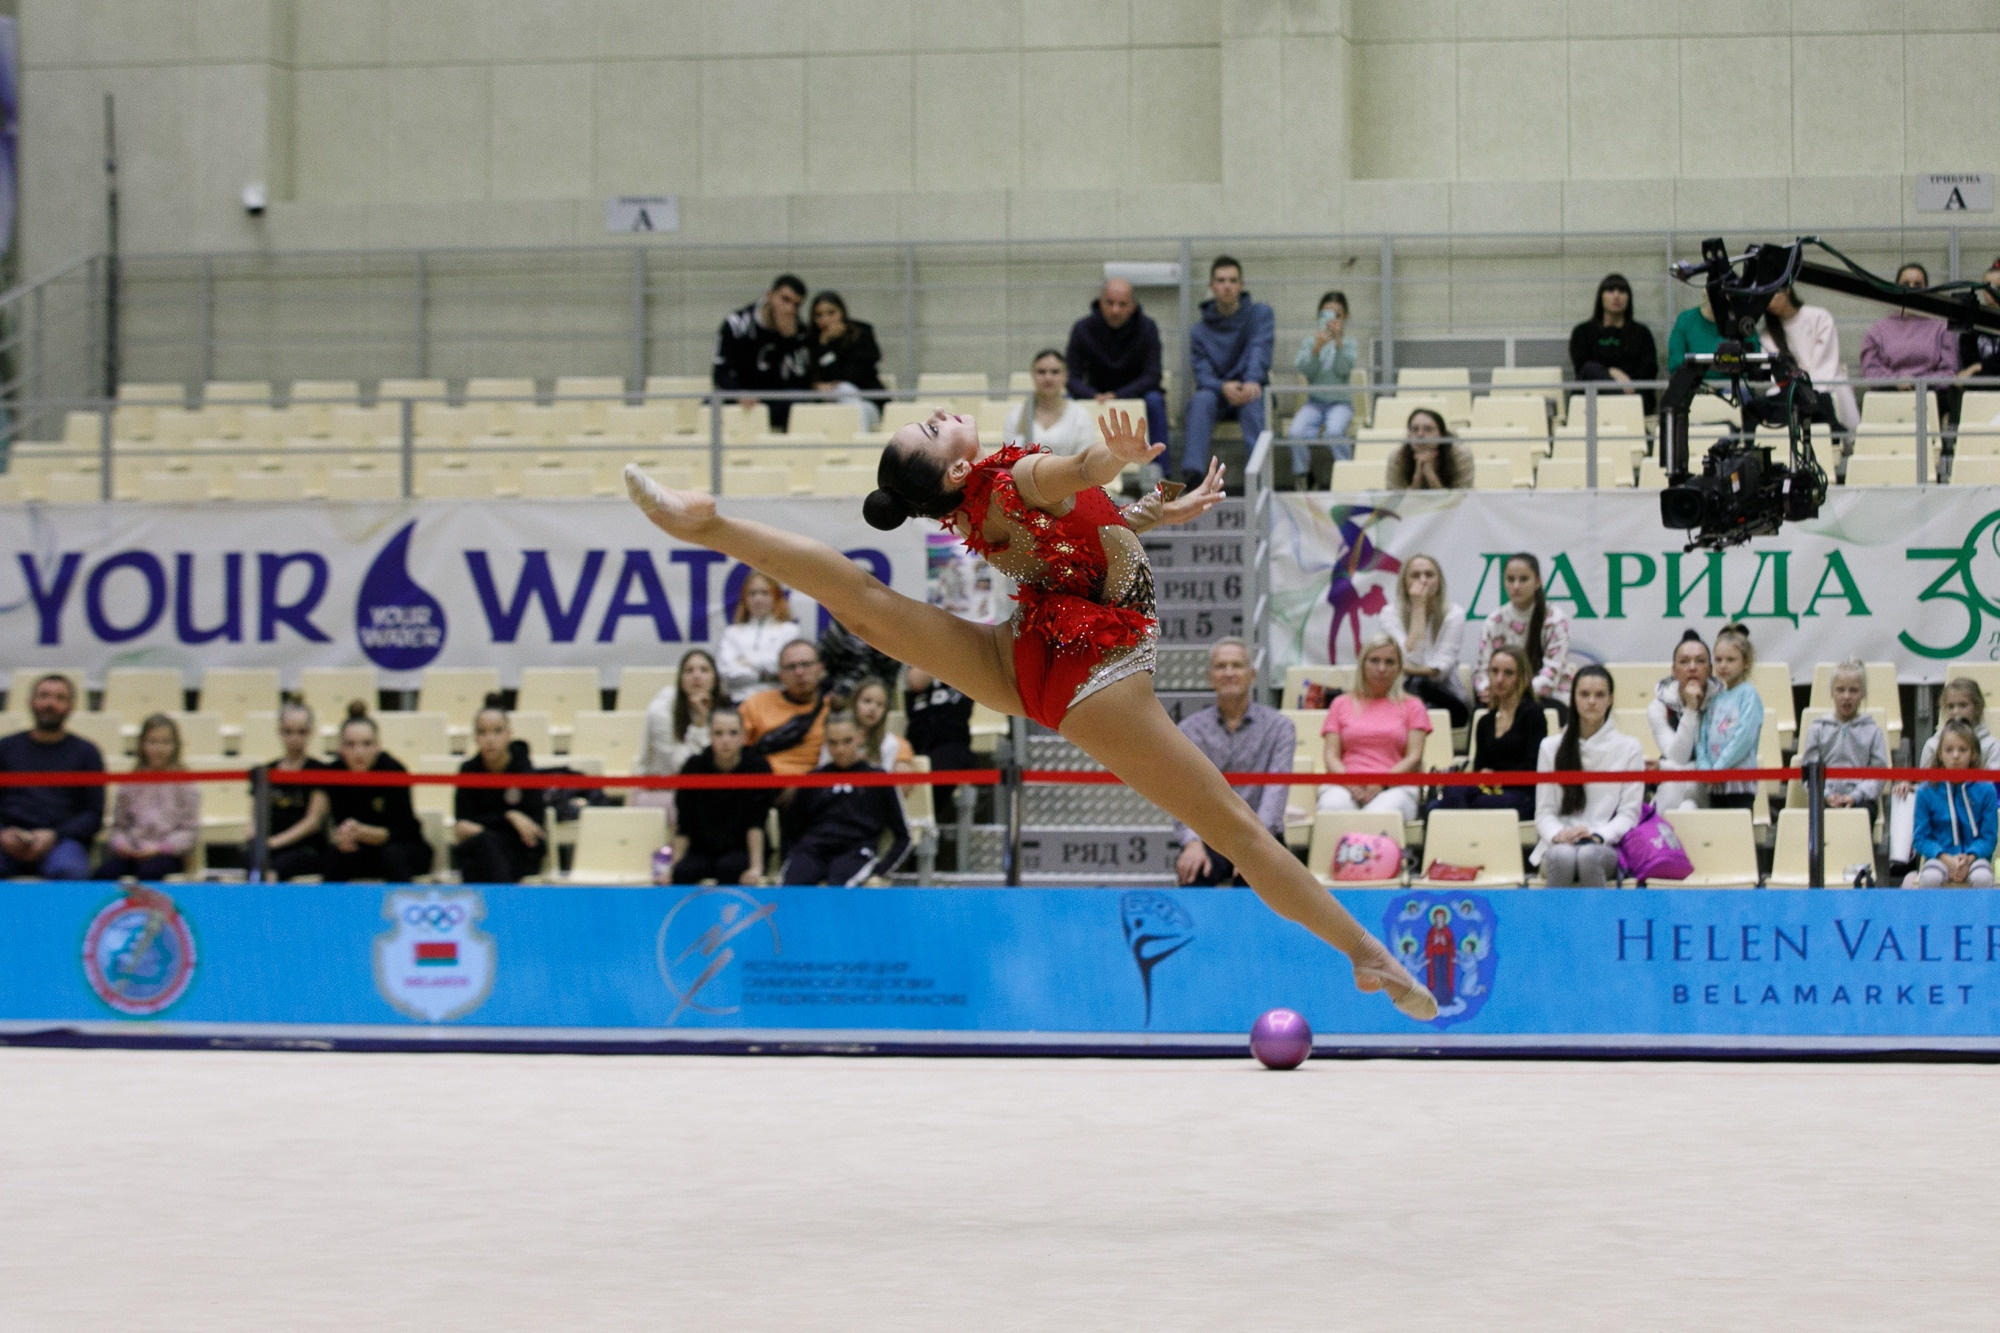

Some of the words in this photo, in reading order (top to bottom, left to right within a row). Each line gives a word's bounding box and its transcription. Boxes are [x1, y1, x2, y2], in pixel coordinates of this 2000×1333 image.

[1193, 544, 1243, 565] РЯД
[17, 550, 334, 645] YOUR
[1164, 580, 1215, 602] РЯД
[1224, 574, 1242, 600] 6
[1195, 612, 1213, 638] 5
[1062, 842, 1119, 866] РЯД
[1128, 836, 1147, 863] 3
[1617, 919, 1808, 962] HELEN
[1672, 984, 1974, 1005] BELAMARKET
